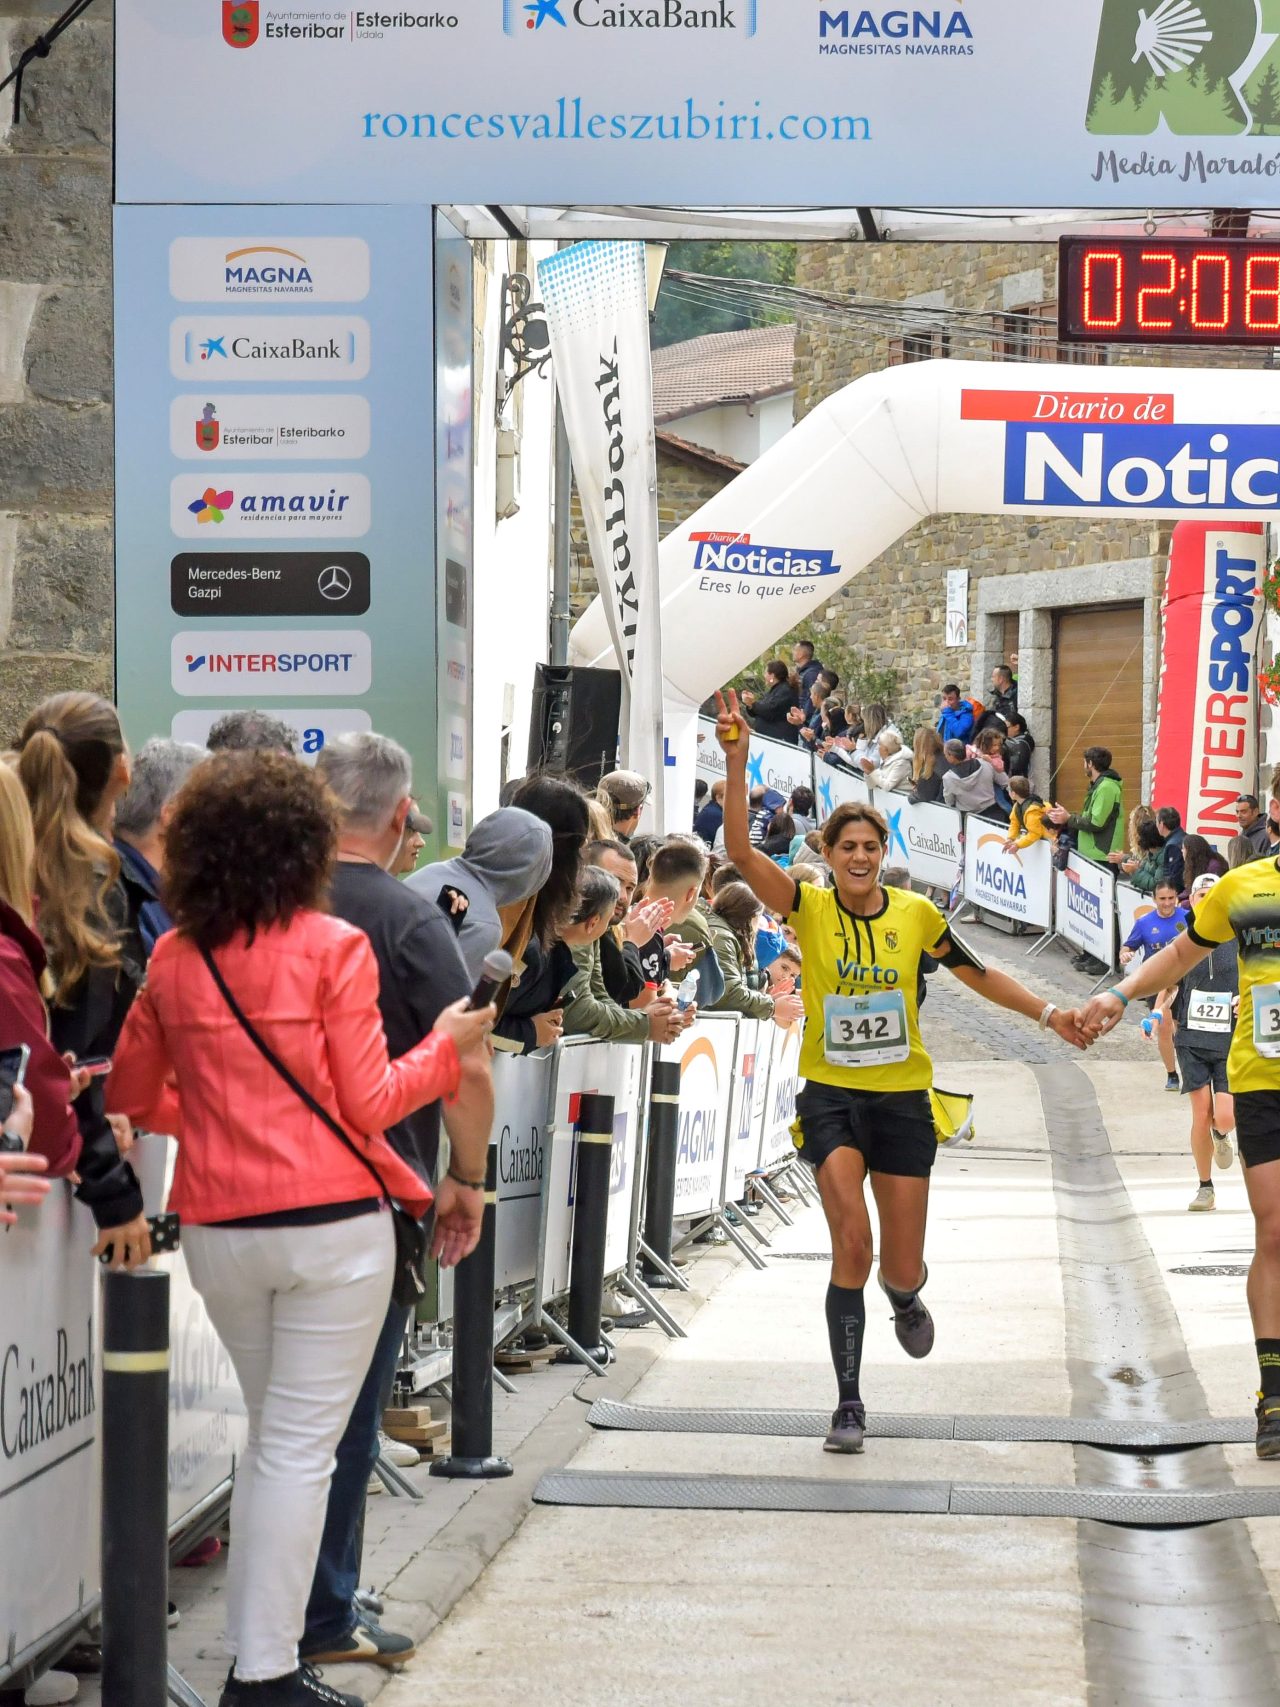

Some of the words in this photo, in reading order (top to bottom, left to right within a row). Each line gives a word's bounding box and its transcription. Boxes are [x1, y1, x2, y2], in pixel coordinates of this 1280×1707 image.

[266, 11, 332, 21] Ayuntamiento
[334, 11, 347, 19] de
[356, 11, 459, 29] Esteribarko
[573, 0, 736, 29] CaixaBank
[819, 10, 974, 39] MAGNA
[266, 22, 345, 40] Esteribar
[356, 30, 384, 39] Udala
[819, 44, 902, 55] MAGNESITAS
[905, 44, 974, 56] NAVARRAS
[362, 97, 873, 140] roncesvalleszubiri.com
[1092, 149, 1177, 182] Media
[226, 268, 313, 283] MAGNA
[232, 338, 341, 359] CaixaBank
[1033, 393, 1123, 420] Diario
[1132, 394, 1166, 420] de
[223, 434, 273, 445] Esteribar
[280, 427, 345, 437] Esteribarko
[240, 489, 350, 512] amavir
[309, 514, 343, 522] mayores
[700, 543, 822, 575] Noticias
[188, 567, 282, 580] Mercedes-Benz
[188, 586, 222, 600] Gazpi
[700, 577, 732, 593] Eres
[738, 580, 750, 595] lo
[757, 584, 784, 599] que
[790, 583, 816, 595] lees
[208, 654, 353, 672] INTERSPORT
[1197, 549, 1257, 839] INTERSPORT
[908, 826, 957, 858] CaixaBank
[976, 859, 1027, 900] MAGNA
[837, 959, 899, 984] Virto
[1196, 1004, 1224, 1018] 427
[840, 1017, 889, 1042] 342
[678, 1109, 717, 1165] AGNA
[500, 1124, 543, 1184] CaixaBa
[1, 1316, 96, 1460] CaixaBank
